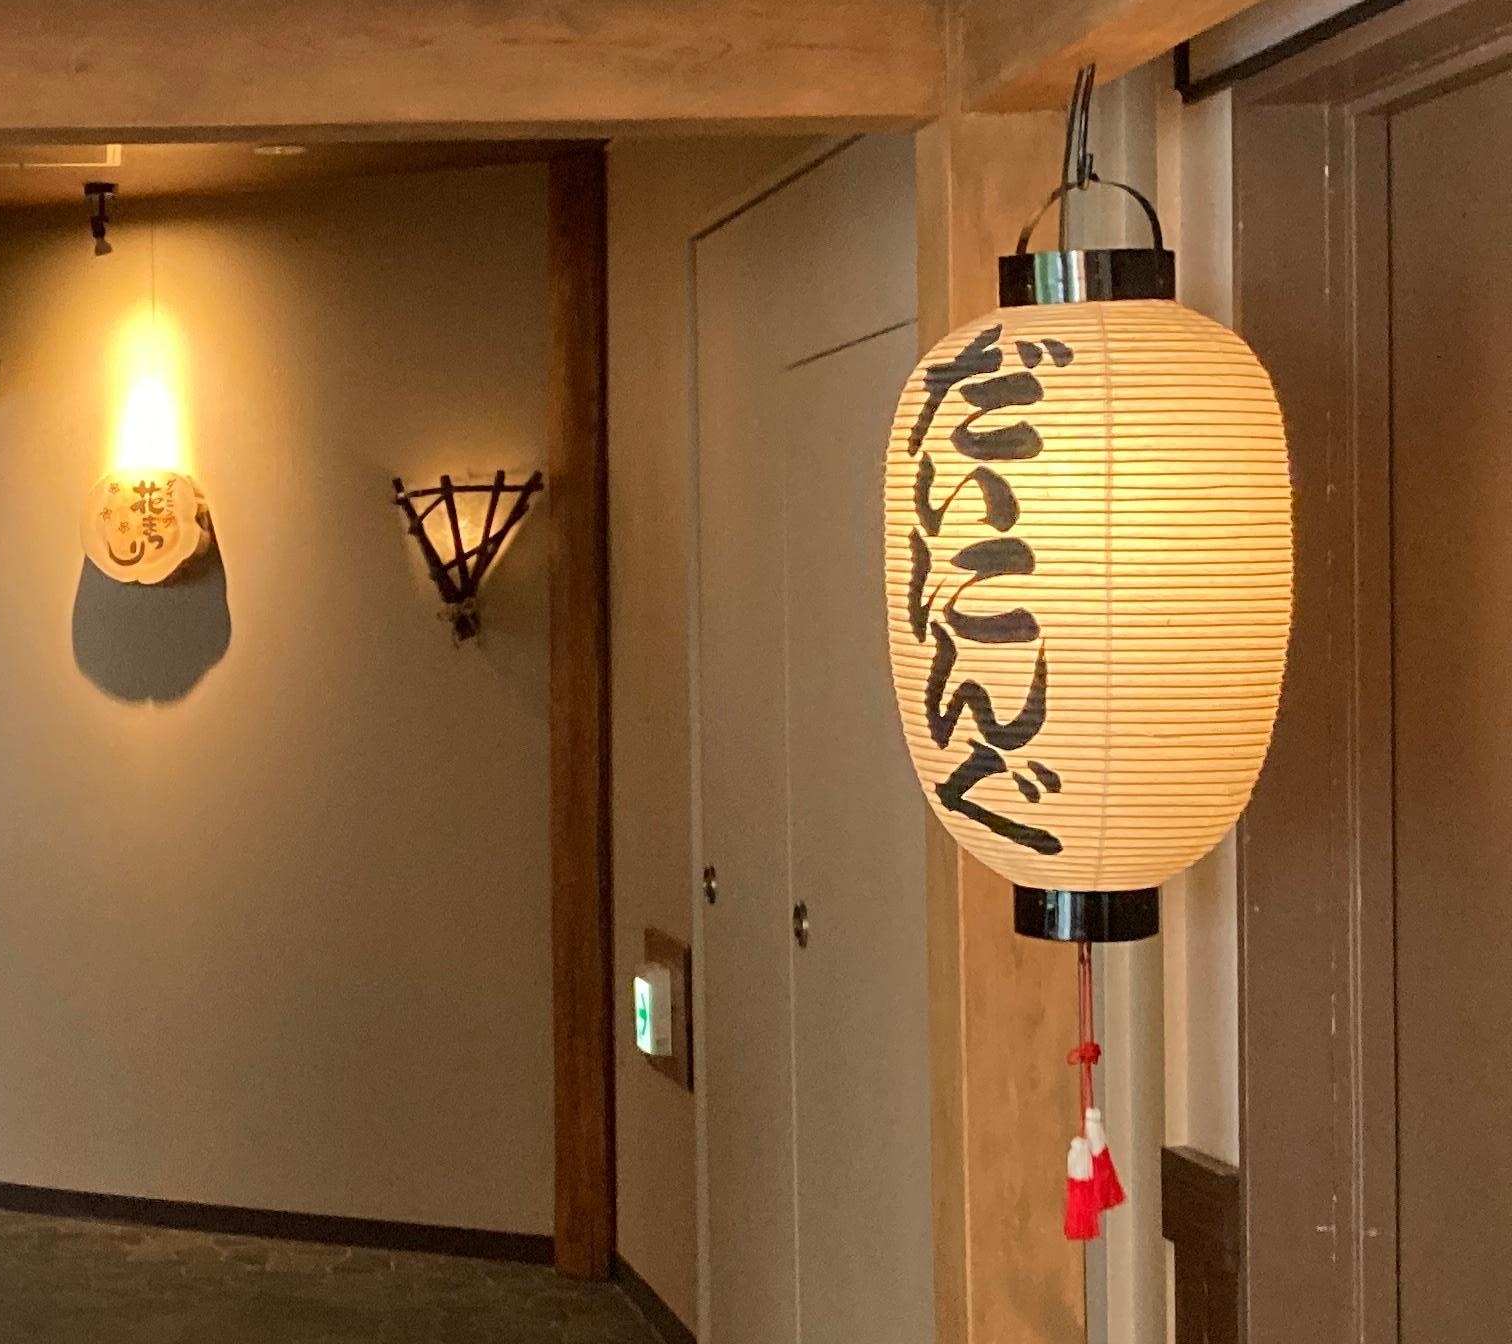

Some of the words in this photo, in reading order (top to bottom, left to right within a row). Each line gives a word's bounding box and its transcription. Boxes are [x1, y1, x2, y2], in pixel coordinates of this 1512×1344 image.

[107, 479, 165, 567] 花まつり
[907, 323, 1074, 856] だいにんぐ
